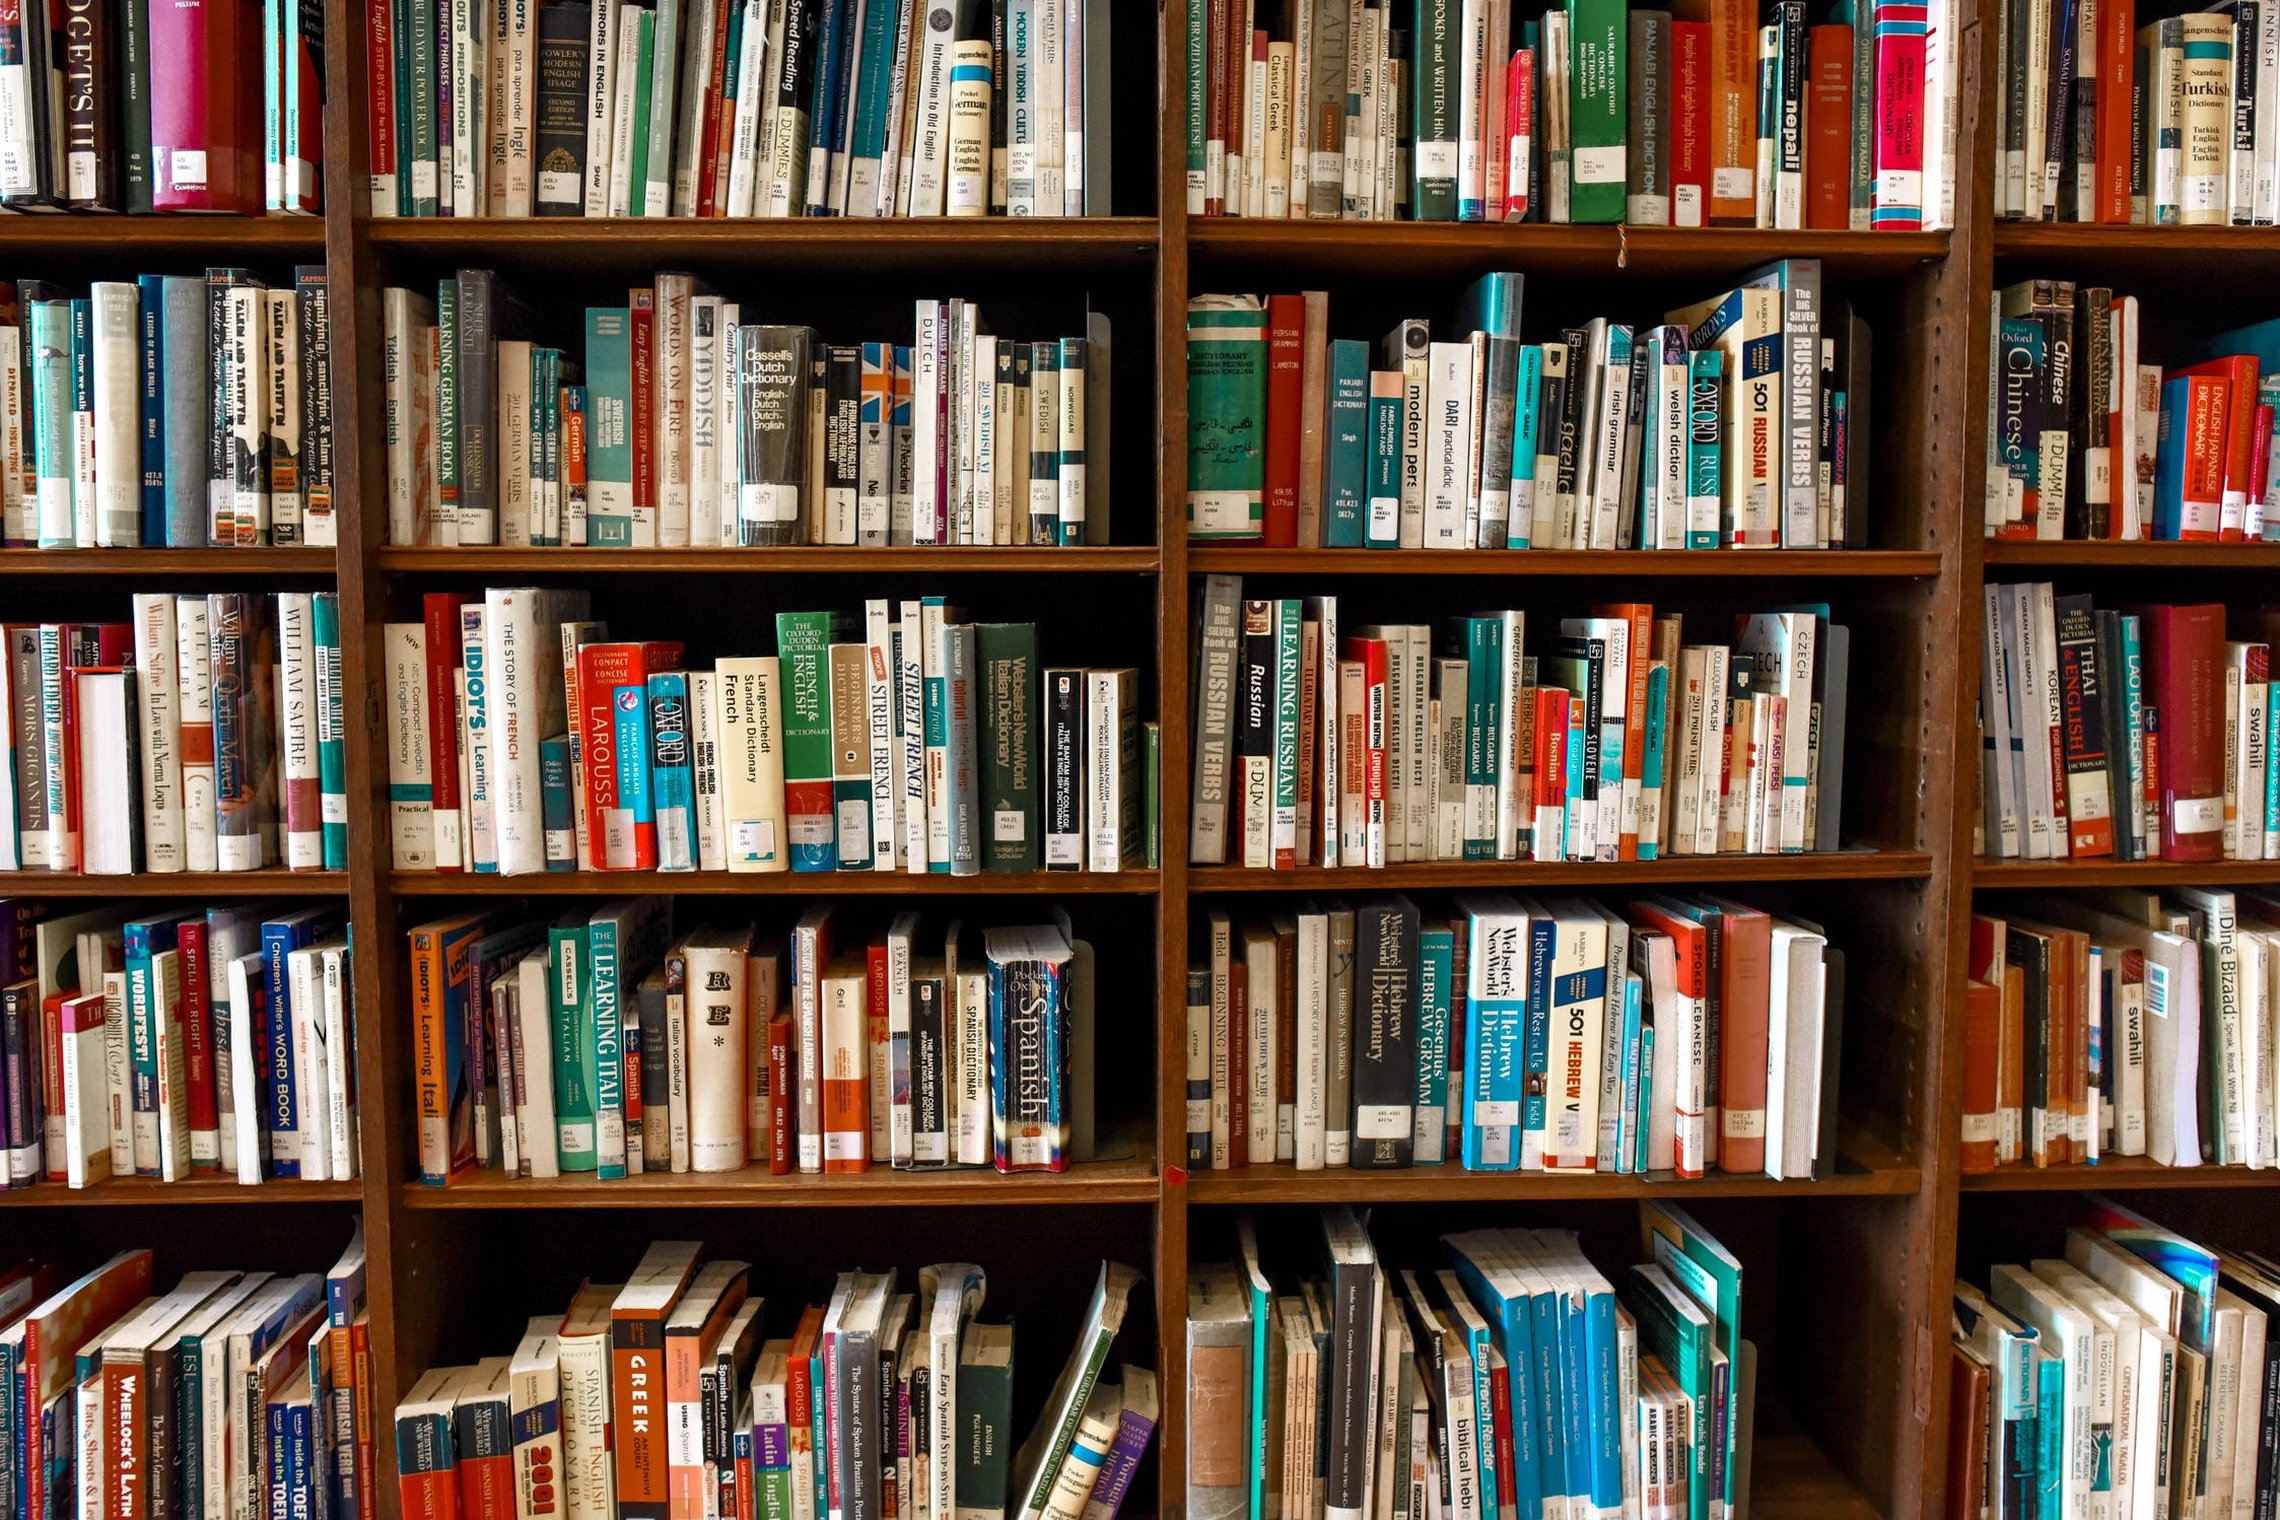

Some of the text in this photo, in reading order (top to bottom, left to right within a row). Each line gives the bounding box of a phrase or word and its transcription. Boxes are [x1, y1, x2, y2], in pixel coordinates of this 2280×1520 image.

[440, 1, 449, 87] PERFECT PHRASES
[544, 70, 582, 78] ENGLISH
[595, 0, 607, 119] ERRORS IN ENGLISH
[895, 24, 910, 94] BY ALL MEANS
[1363, 17, 1373, 98] COLLOQUIAL GREEK
[1586, 42, 1596, 98] DICTIONARY
[1597, 50, 1606, 91] CONCISE
[1608, 25, 1616, 116] SAURABH'S OXFORD
[2060, 47, 2072, 86] SOMALI
[457, 42, 466, 138] PREPOSITIONS
[548, 80, 577, 88] USAGE
[1191, 21, 1200, 147] BRAZILIAN PORTUGUESE
[1269, 55, 1280, 132] Classical Greek
[2171, 59, 2182, 118] FINNISH
[1783, 100, 1800, 169] nepali
[174, 183, 207, 192] CAMBRIDGE
[146, 311, 155, 398] LEXICON OF BLACK ENGLISH
[669, 294, 684, 437] WORDS ON FIRE
[923, 318, 933, 373] DUTCH
[939, 355, 947, 395] AFRIKAANS
[2052, 340, 2068, 404] Chinese
[386, 335, 399, 445] Yiddish English
[441, 303, 453, 481] LEARNING GERMAN BOOK
[695, 337, 714, 448] YIDDISH
[981, 381, 991, 456] 201 SWEDISH
[1039, 389, 1049, 434] SWEDISH
[1792, 337, 1812, 486] RUSSIAN VERBS
[1822, 388, 1830, 447] Russian Phrases
[2006, 347, 2032, 460] Chinese
[571, 416, 582, 462] German
[829, 416, 838, 462] DICTIONARY
[838, 400, 847, 479] ENGLISH/AFRIKAANS
[1379, 405, 1387, 456] ENGLISH-FARSI
[1386, 405, 1394, 456] FARSI-ENGLISH
[1443, 400, 1459, 465] DARI practical
[1607, 390, 1623, 472] irish grammar
[1753, 382, 1767, 478] 501 RUSSIAN
[1612, 628, 1620, 669] SLOVENE
[1797, 632, 1808, 680] CZECH
[2080, 646, 2097, 697] THAI
[286, 608, 306, 766] WILLIAM SAFIRE
[504, 622, 518, 760] THE STORY OF FRENCH
[725, 674, 739, 724] French
[793, 654, 806, 716] ENGLISH
[1250, 664, 1265, 728] Russian
[1280, 623, 1297, 797] LEARNING RUSSIAN
[2129, 655, 2142, 726] LAO FOR
[412, 686, 424, 775] Compact Swedish
[571, 733, 581, 763] FRENCH
[744, 674, 757, 783] Standard Dictionary
[904, 661, 923, 800] STREET FRENCH
[930, 709, 942, 742] french
[1202, 652, 1229, 800] RUSSIAN VERBS
[1471, 727, 1480, 775] BULGARIAN
[1486, 727, 1495, 774] BULGARIAN
[1549, 732, 1562, 781] Bosnian
[2249, 707, 2264, 769] swahili
[2146, 736, 2157, 789] Mandarin
[1062, 795, 1070, 828] COLLEGE
[565, 947, 573, 999] CASSELL'S
[895, 945, 904, 995] SPANISH
[1216, 932, 1226, 957] Held
[1501, 927, 1517, 997] Webster's
[187, 948, 200, 1050] SPELL IT RIGHT
[874, 959, 885, 1013] LAROUSSE
[1389, 975, 1408, 1041] Hebrew
[1421, 959, 1435, 1032] HEBREW
[271, 942, 290, 1127] Children's Writer's WORD BOOK
[563, 1011, 571, 1063] ITALIAN
[1337, 988, 1347, 1080] HEBREW IN AMERICA
[1366, 975, 1389, 1063] Dictionary
[1499, 1010, 1519, 1081] Hebrew
[2128, 1006, 2142, 1066] swahili
[627, 1057, 639, 1100] Spanish
[671, 1018, 681, 1097] italian vocabulary
[1011, 996, 1048, 1115] Spanish
[1566, 1007, 1584, 1099] 501 HEBREW
[183, 1354, 196, 1381] ESL
[333, 1312, 352, 1475] THE ULTIMATE PHRASAL VERB
[630, 1354, 649, 1434] GREEK
[794, 1370, 806, 1424] LAROUSSE
[680, 1405, 691, 1465] USING Spanish
[851, 1366, 864, 1498] The Syntax of Spoken Brazilian
[1476, 1342, 1495, 1471] Easy French Reader
[1649, 1408, 1659, 1439] ARABIC
[1677, 1405, 1686, 1435] ARABIC
[562, 1370, 582, 1511] DICTIONARY
[764, 1426, 778, 1465] Latin
[973, 1414, 981, 1466] PORTUGUESE
[984, 1425, 993, 1456] ENGLISH
[531, 1445, 555, 1515] 2001
